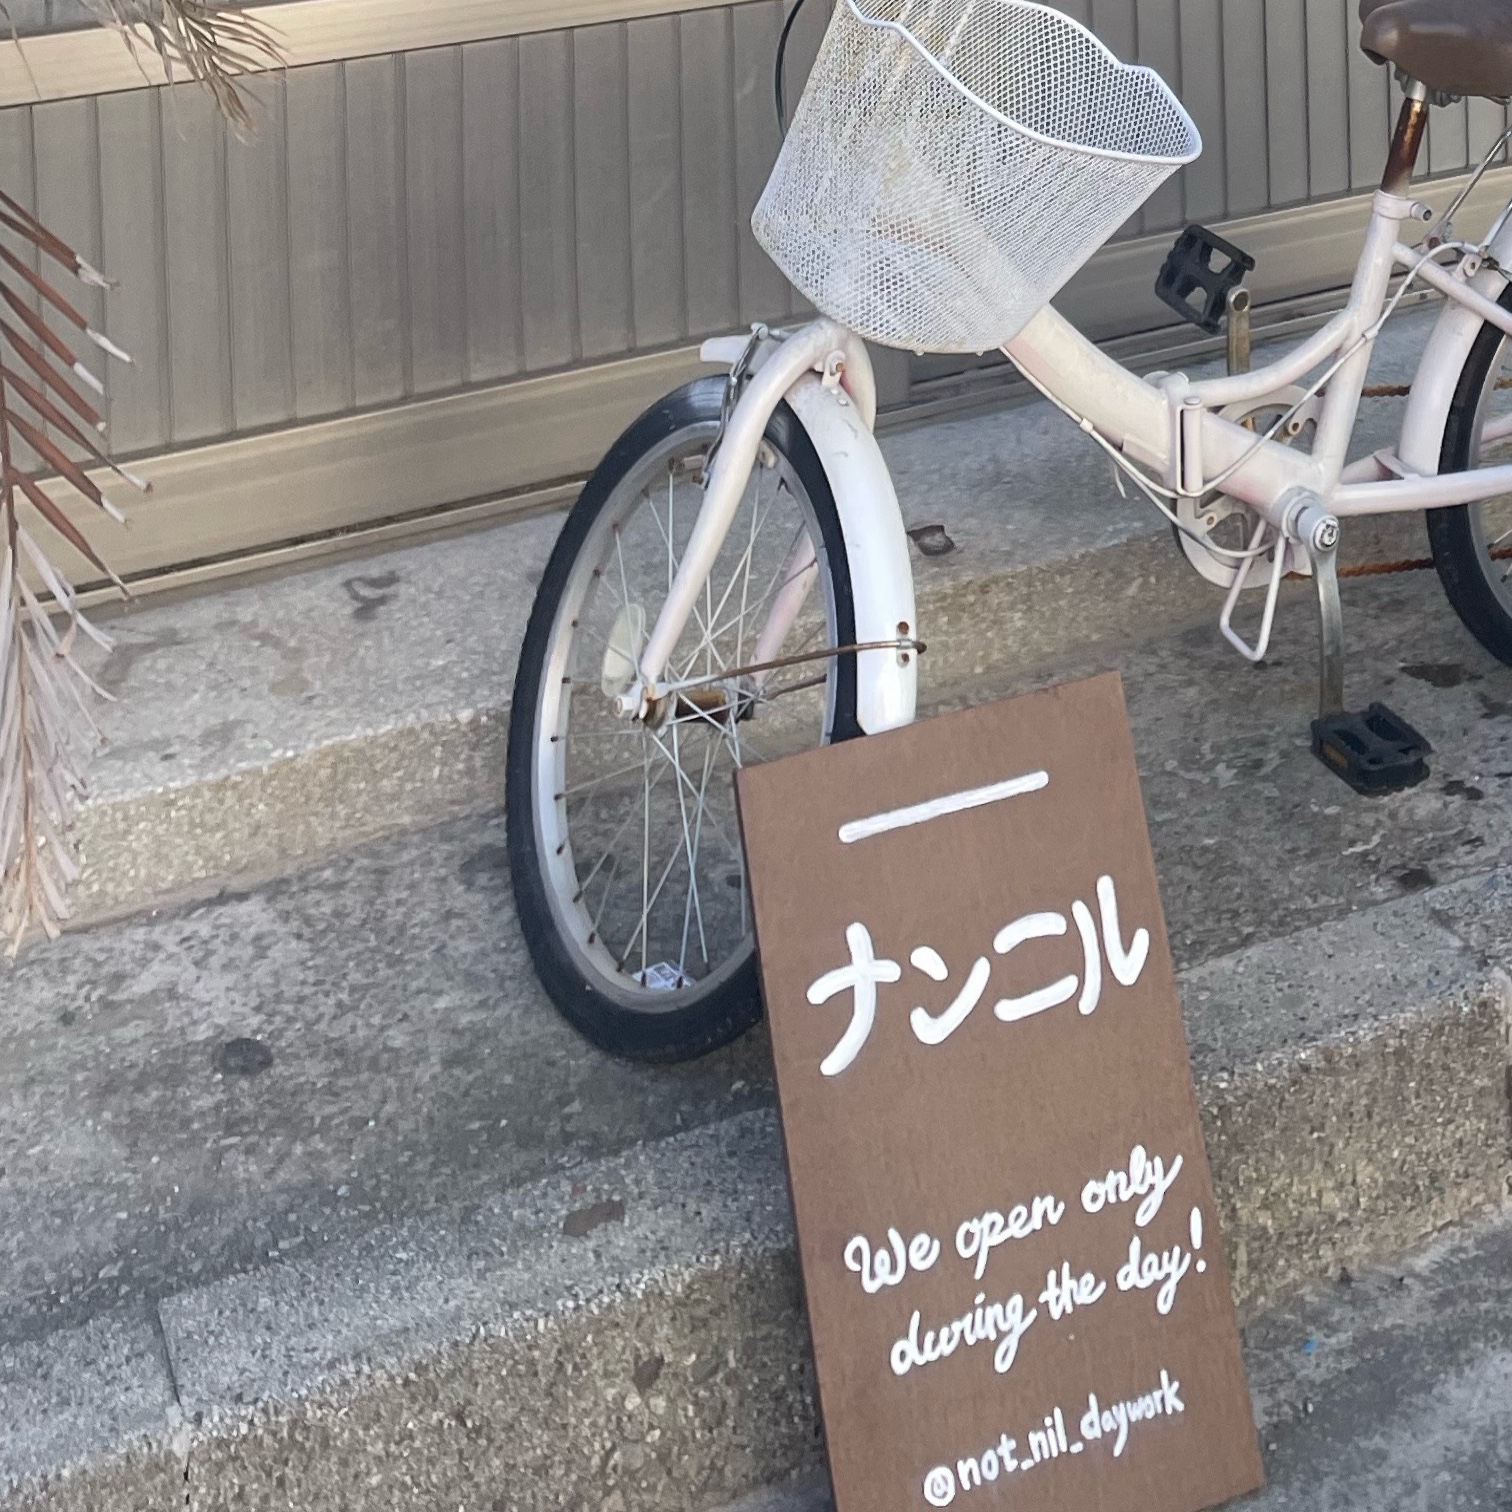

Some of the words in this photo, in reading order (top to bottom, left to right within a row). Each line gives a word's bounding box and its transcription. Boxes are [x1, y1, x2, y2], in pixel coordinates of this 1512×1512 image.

[806, 874, 1150, 1077] ナンニル
[843, 1227, 941, 1294] We
[955, 1194, 1066, 1280] open
[1080, 1144, 1184, 1227] only
[890, 1291, 1038, 1376] during
[1038, 1261, 1107, 1321] the
[1116, 1206, 1207, 1315] day!
[923, 1368, 1185, 1508] @not_nil_daywork
